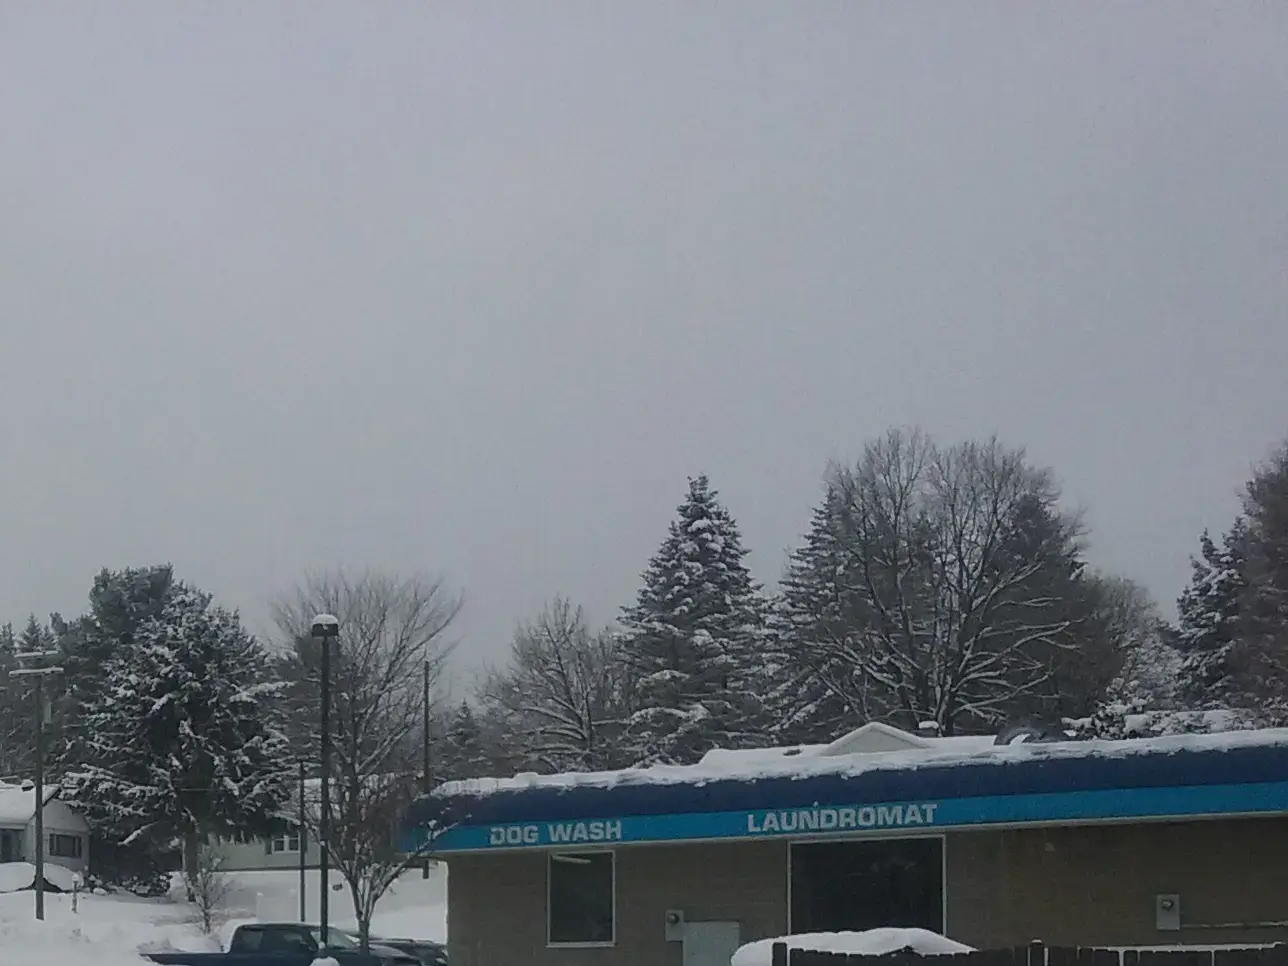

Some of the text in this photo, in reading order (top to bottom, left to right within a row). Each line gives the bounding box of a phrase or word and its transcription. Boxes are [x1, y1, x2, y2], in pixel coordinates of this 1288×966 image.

[489, 819, 623, 845] DOG WASH
[747, 803, 938, 833] LAUNDROMAT
